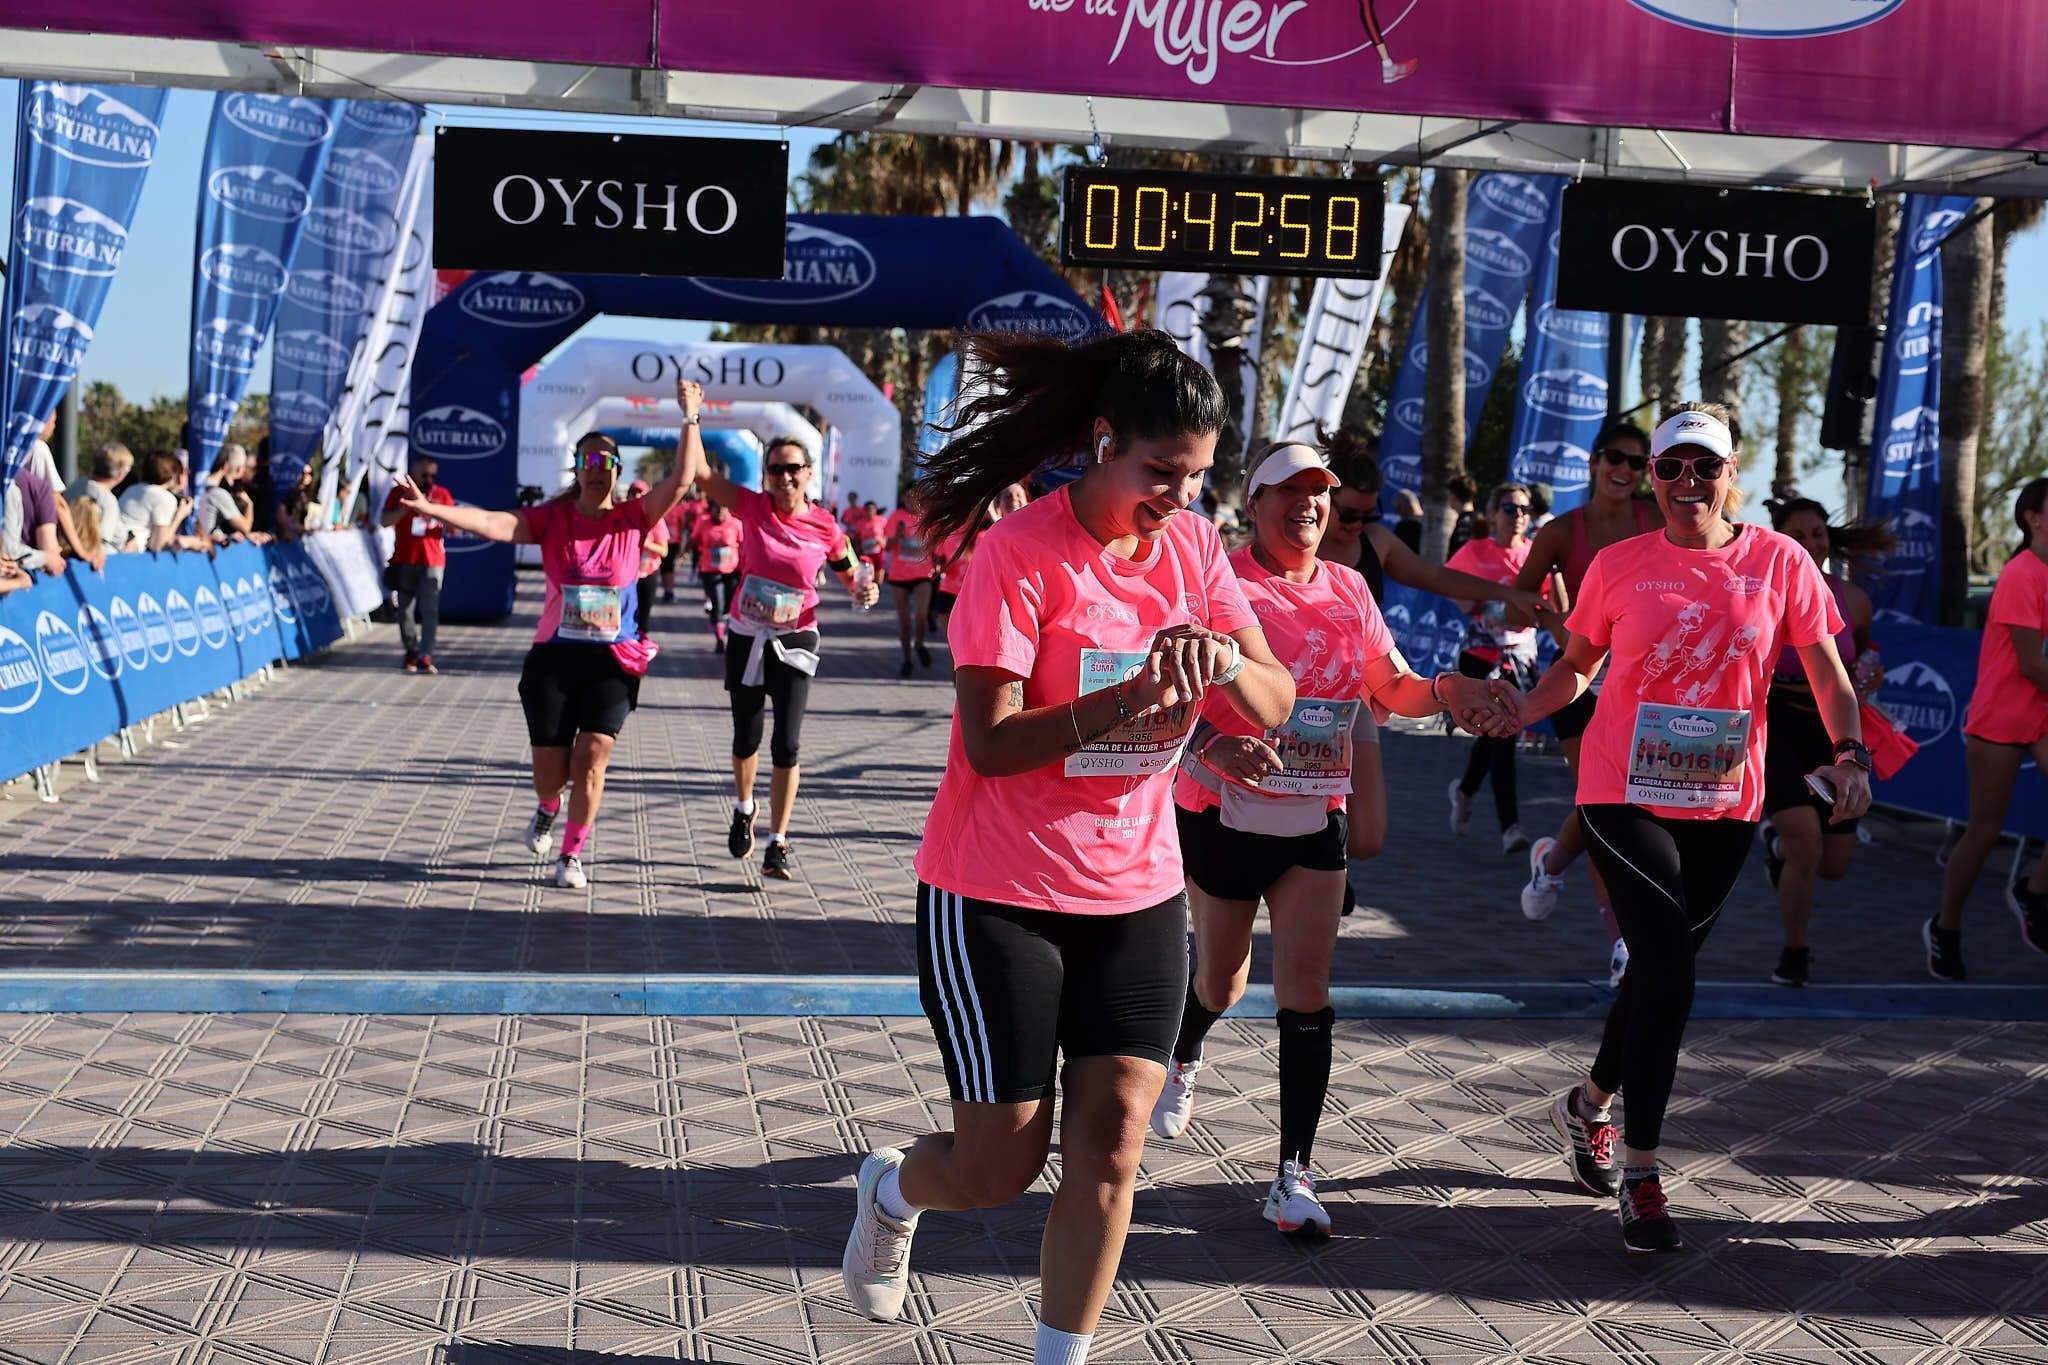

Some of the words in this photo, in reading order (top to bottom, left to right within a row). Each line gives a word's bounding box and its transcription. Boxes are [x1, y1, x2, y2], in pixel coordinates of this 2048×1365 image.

[31, 98, 152, 160] ASTURIANA
[492, 174, 738, 235] OYSHO
[1086, 184, 1360, 261] 00:42:58
[1611, 224, 1829, 282] OYSHO
[471, 289, 574, 313] ASTURIANA
[632, 352, 785, 388] OYSHO
[416, 426, 500, 448] ASTURIANA
[1636, 581, 1685, 592] OYSHO
[1086, 604, 1135, 624] OYSHO
[1091, 664, 1115, 672] SUMA
[1671, 720, 1714, 734] ASTURIANA
[1129, 733, 1152, 742] 3956
[1112, 744, 1121, 752] DE
[1123, 744, 1132, 752] LA
[1135, 743, 1158, 752] MUJER
[1297, 742, 1332, 758] 016
[1081, 758, 1124, 768] OYSHO
[1669, 751, 1712, 769] 016
[1269, 780, 1302, 790] OYSHO
[1633, 777, 1662, 787] CARRERA
[1638, 789, 1675, 801] OYSHO
